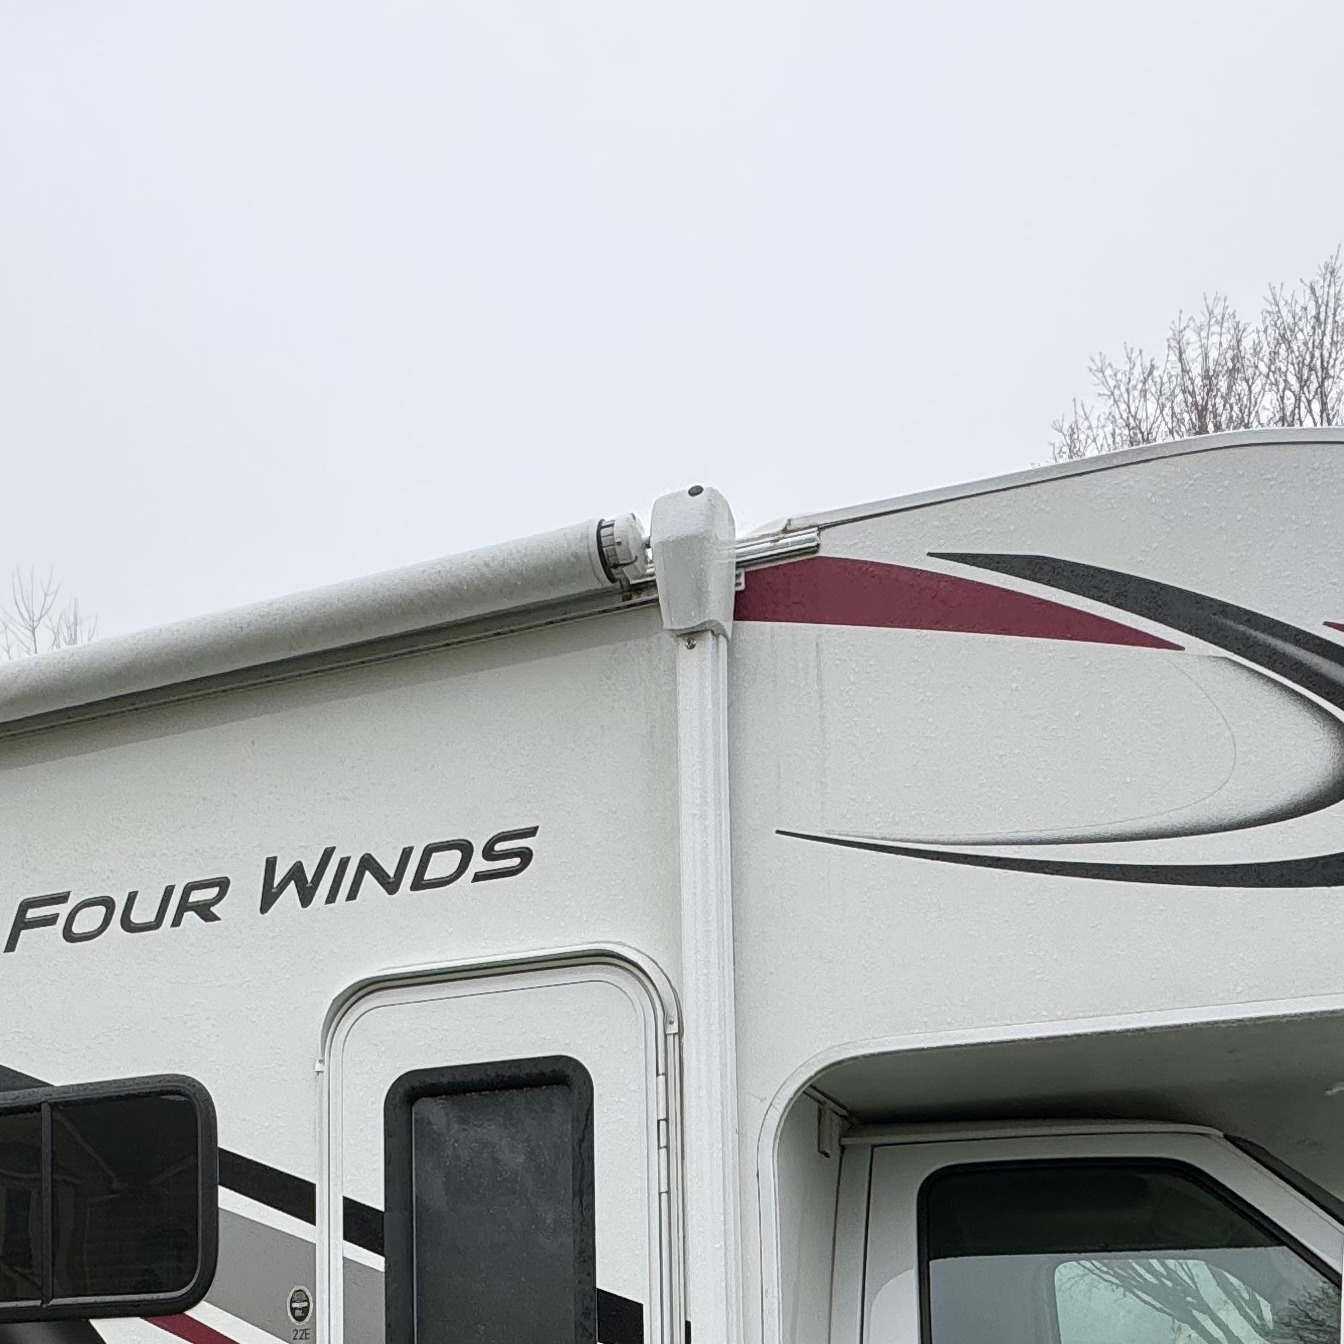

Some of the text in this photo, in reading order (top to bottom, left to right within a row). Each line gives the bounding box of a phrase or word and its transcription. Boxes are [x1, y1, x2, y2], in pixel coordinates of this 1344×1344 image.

[3, 826, 539, 953] FOUR WINDS
[292, 1328, 311, 1341] 22E
